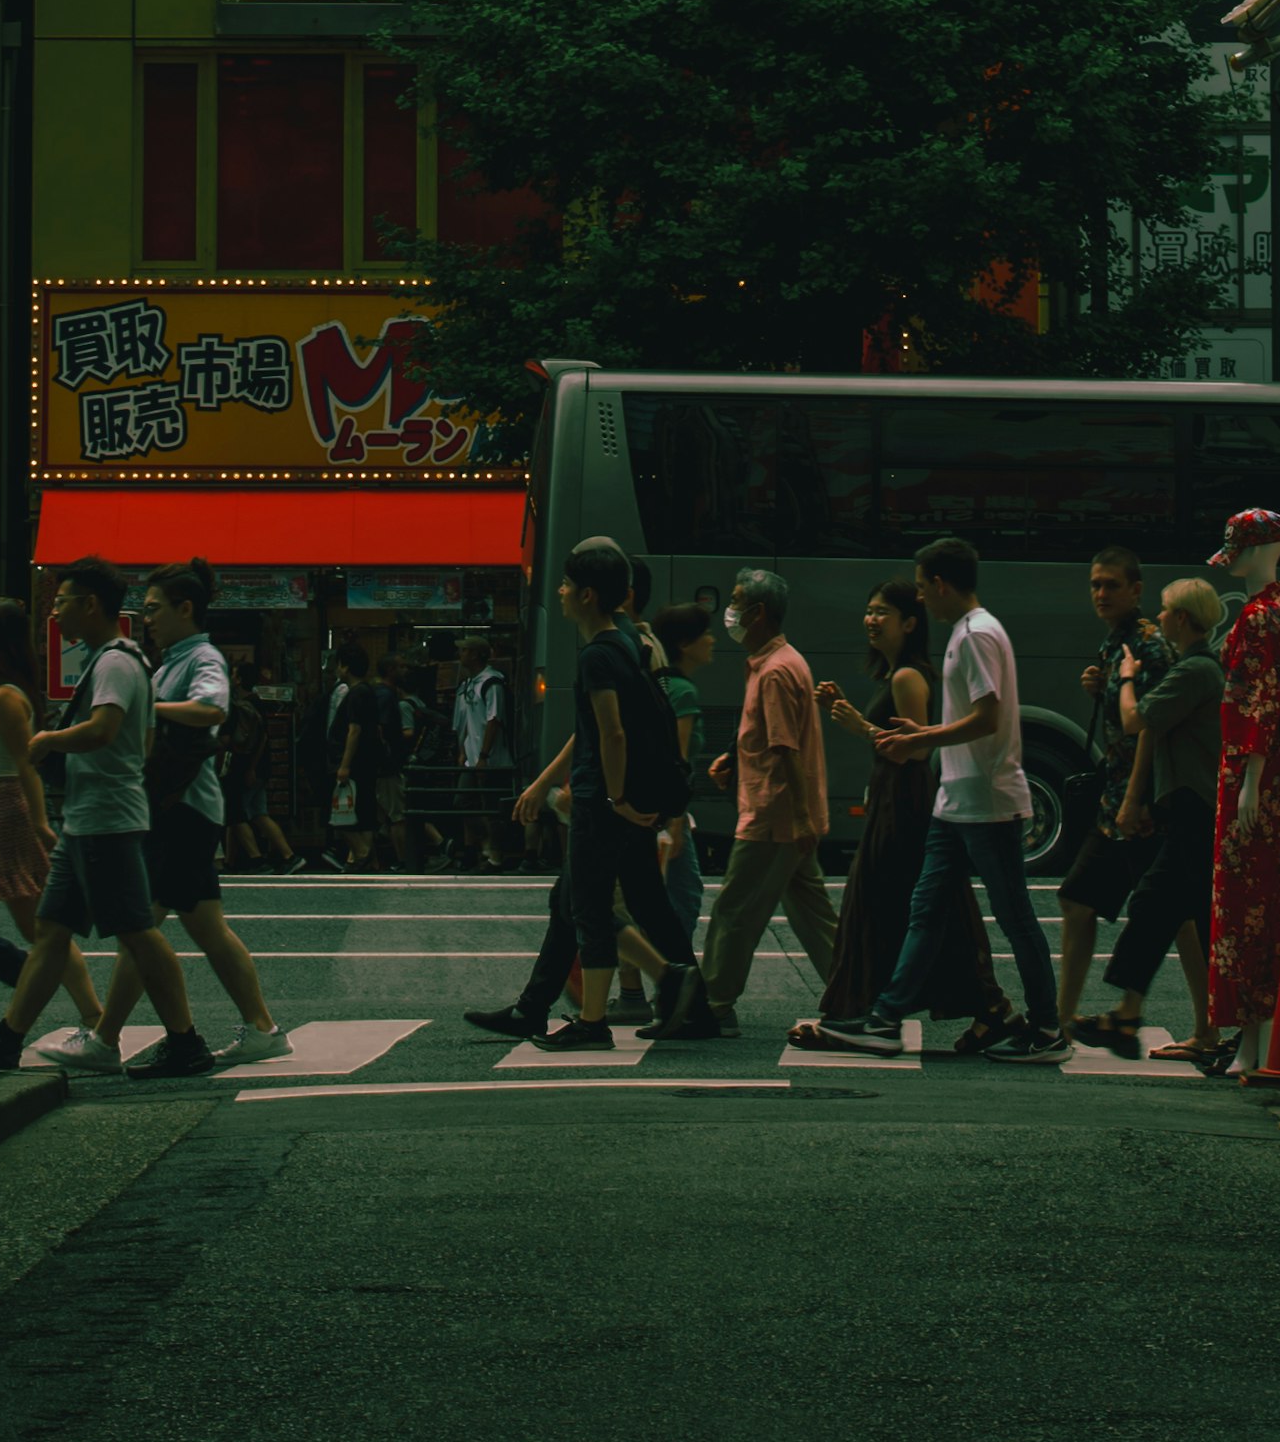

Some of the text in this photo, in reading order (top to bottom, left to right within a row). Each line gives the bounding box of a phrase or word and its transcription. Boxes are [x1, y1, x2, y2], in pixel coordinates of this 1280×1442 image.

[52, 297, 170, 389] 買取
[178, 333, 294, 413] 市場
[1160, 356, 1238, 379] 価買取
[79, 381, 188, 463] 販売
[328, 417, 472, 466] ムーラン
